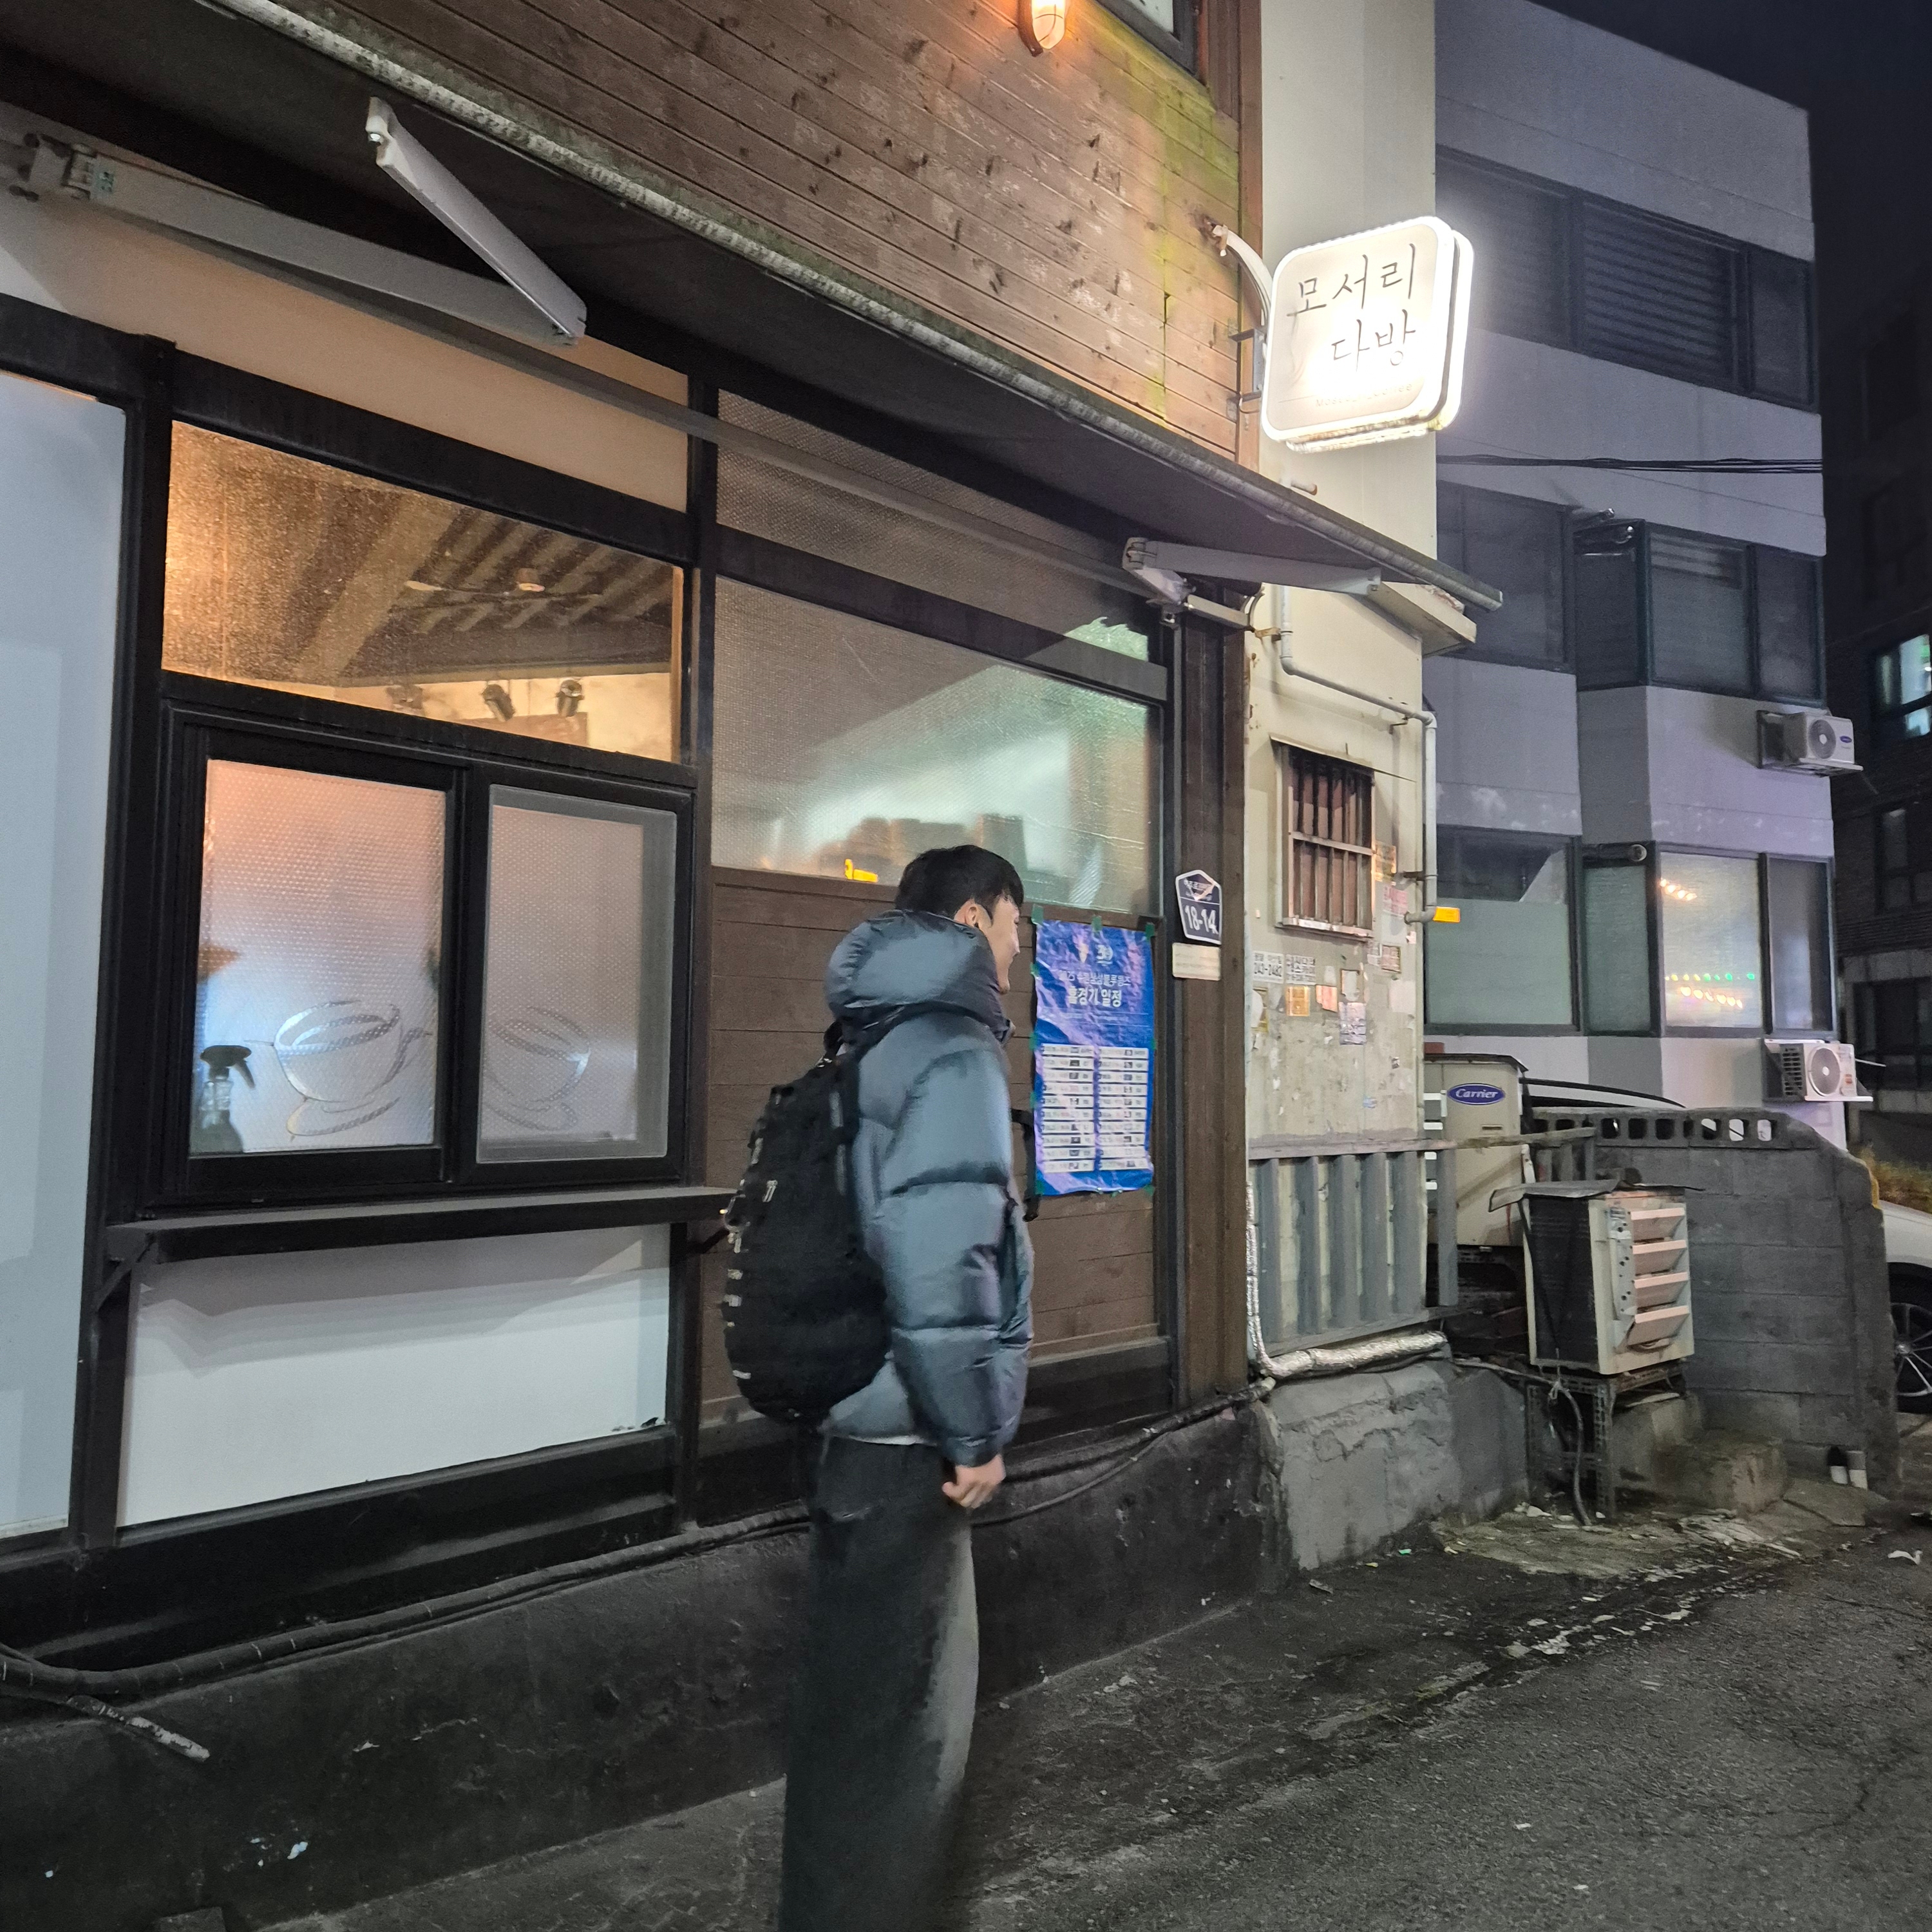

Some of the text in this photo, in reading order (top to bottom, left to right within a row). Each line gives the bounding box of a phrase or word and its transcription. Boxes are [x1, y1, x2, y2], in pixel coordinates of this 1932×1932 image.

[1286, 242, 1416, 317] 모서리
[1331, 308, 1416, 372] 다방
[1184, 905, 1219, 934] 18-14
[1101, 989, 1122, 1007] 일정
[1455, 1088, 1498, 1098] Carrier
